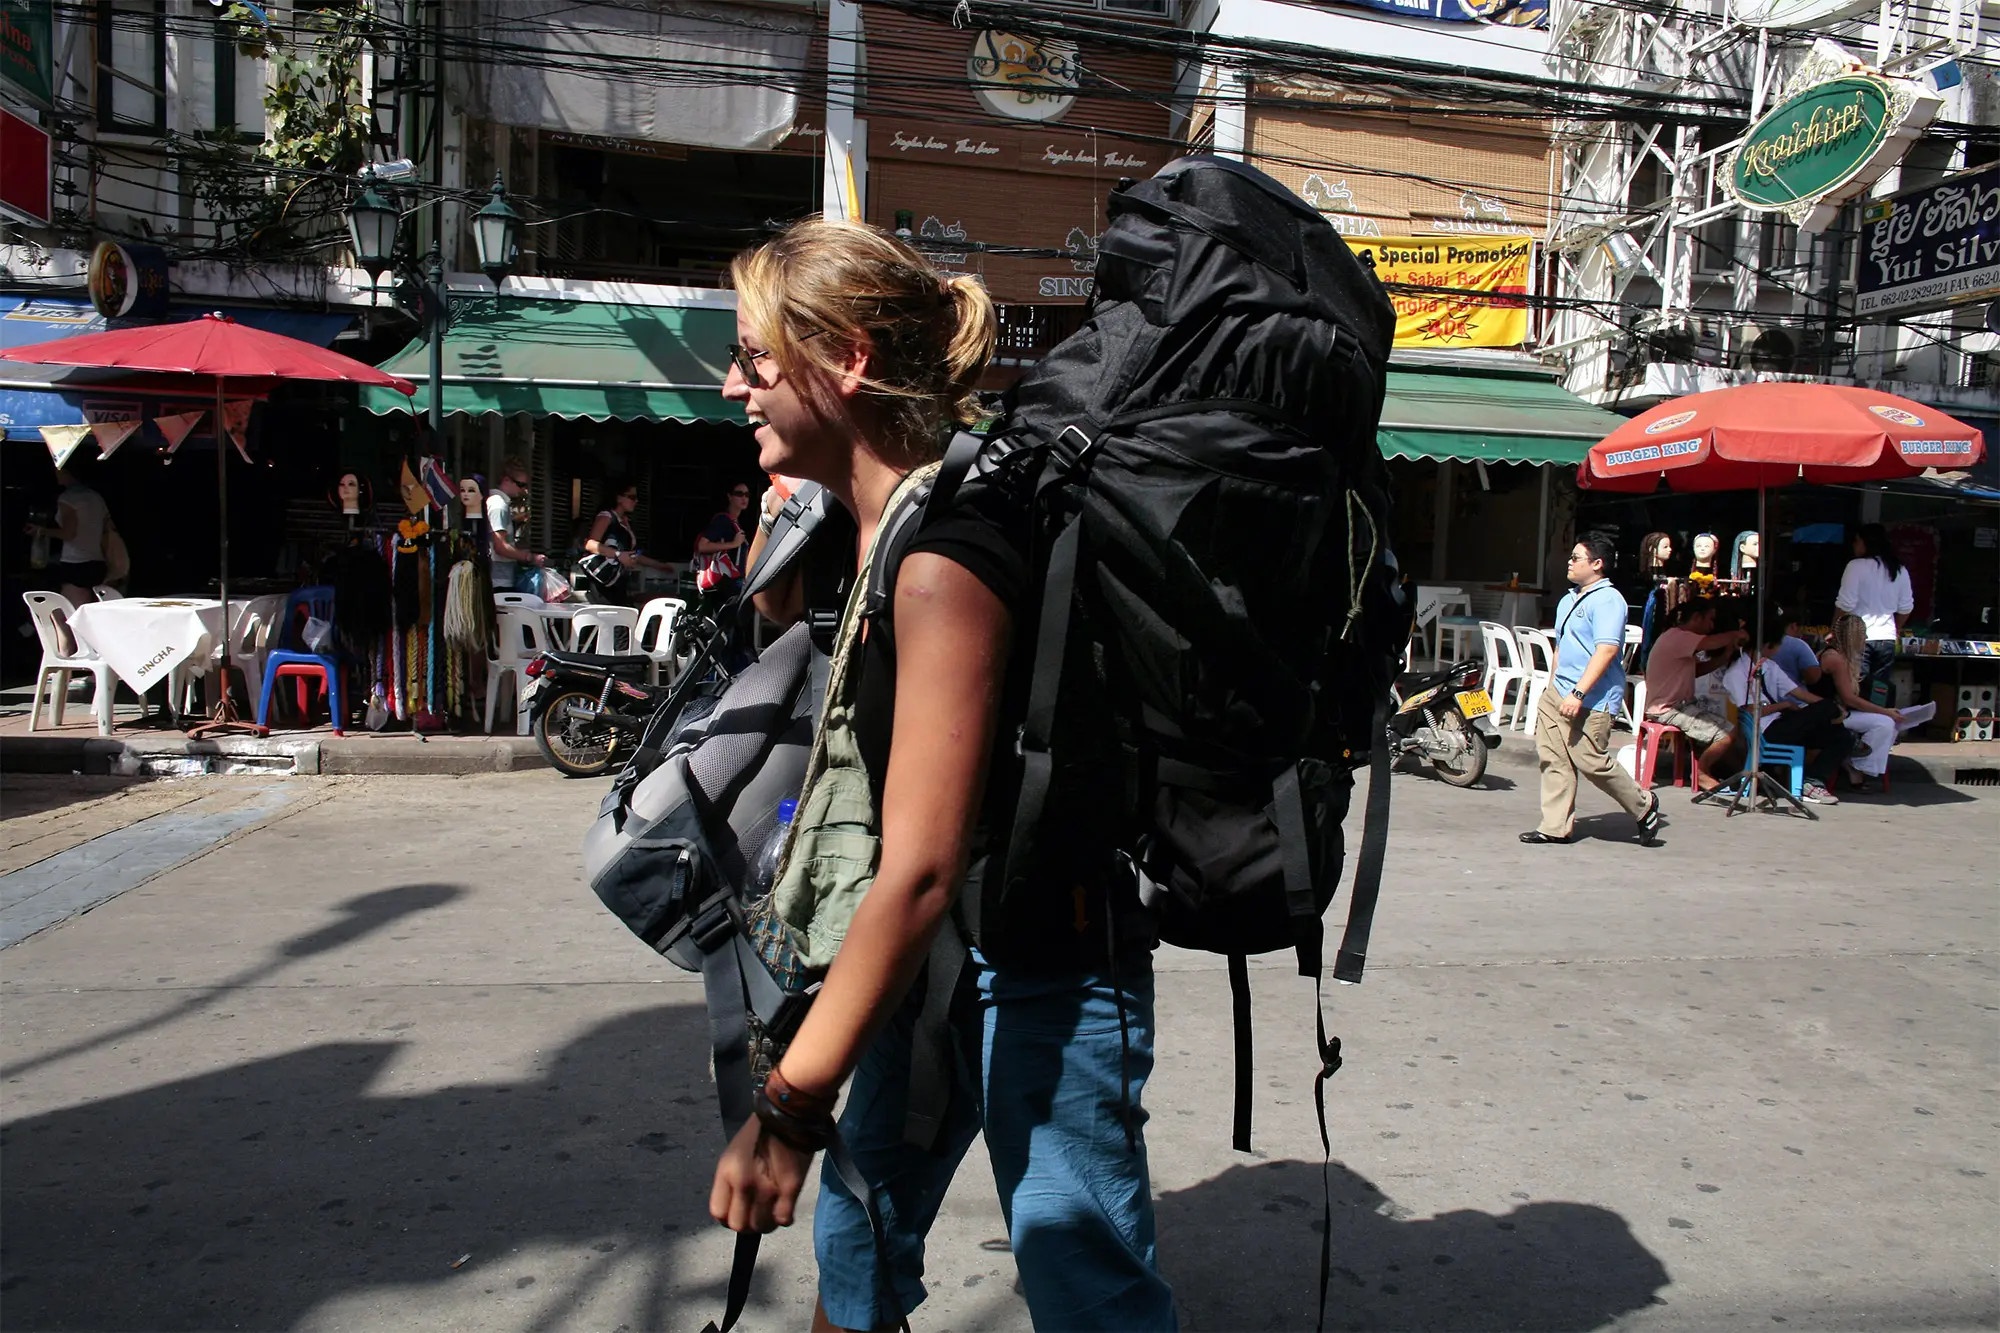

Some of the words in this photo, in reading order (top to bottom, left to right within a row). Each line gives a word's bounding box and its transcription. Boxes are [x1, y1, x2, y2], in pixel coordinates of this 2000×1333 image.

[1324, 214, 1381, 237] GHA
[1379, 245, 1440, 268] Special
[1447, 241, 1528, 264] Promotion
[1384, 272, 1399, 284] at
[1408, 271, 1449, 287] Sabai
[1456, 270, 1482, 285] Bar
[1876, 249, 1922, 286] Yui
[1038, 276, 1096, 297] SING
[1880, 284, 1949, 307] 662-02-2829224
[1972, 269, 2000, 289] 662-0
[27, 308, 85, 319] VISA
[92, 411, 130, 424] VISA
[1606, 446, 1660, 466] BURGER
[1661, 440, 1700, 457] KING
[1901, 441, 1944, 454] BURGER
[1944, 441, 1971, 454] KING
[137, 645, 176, 677] SINGHA
[1471, 705, 1488, 714] 282
